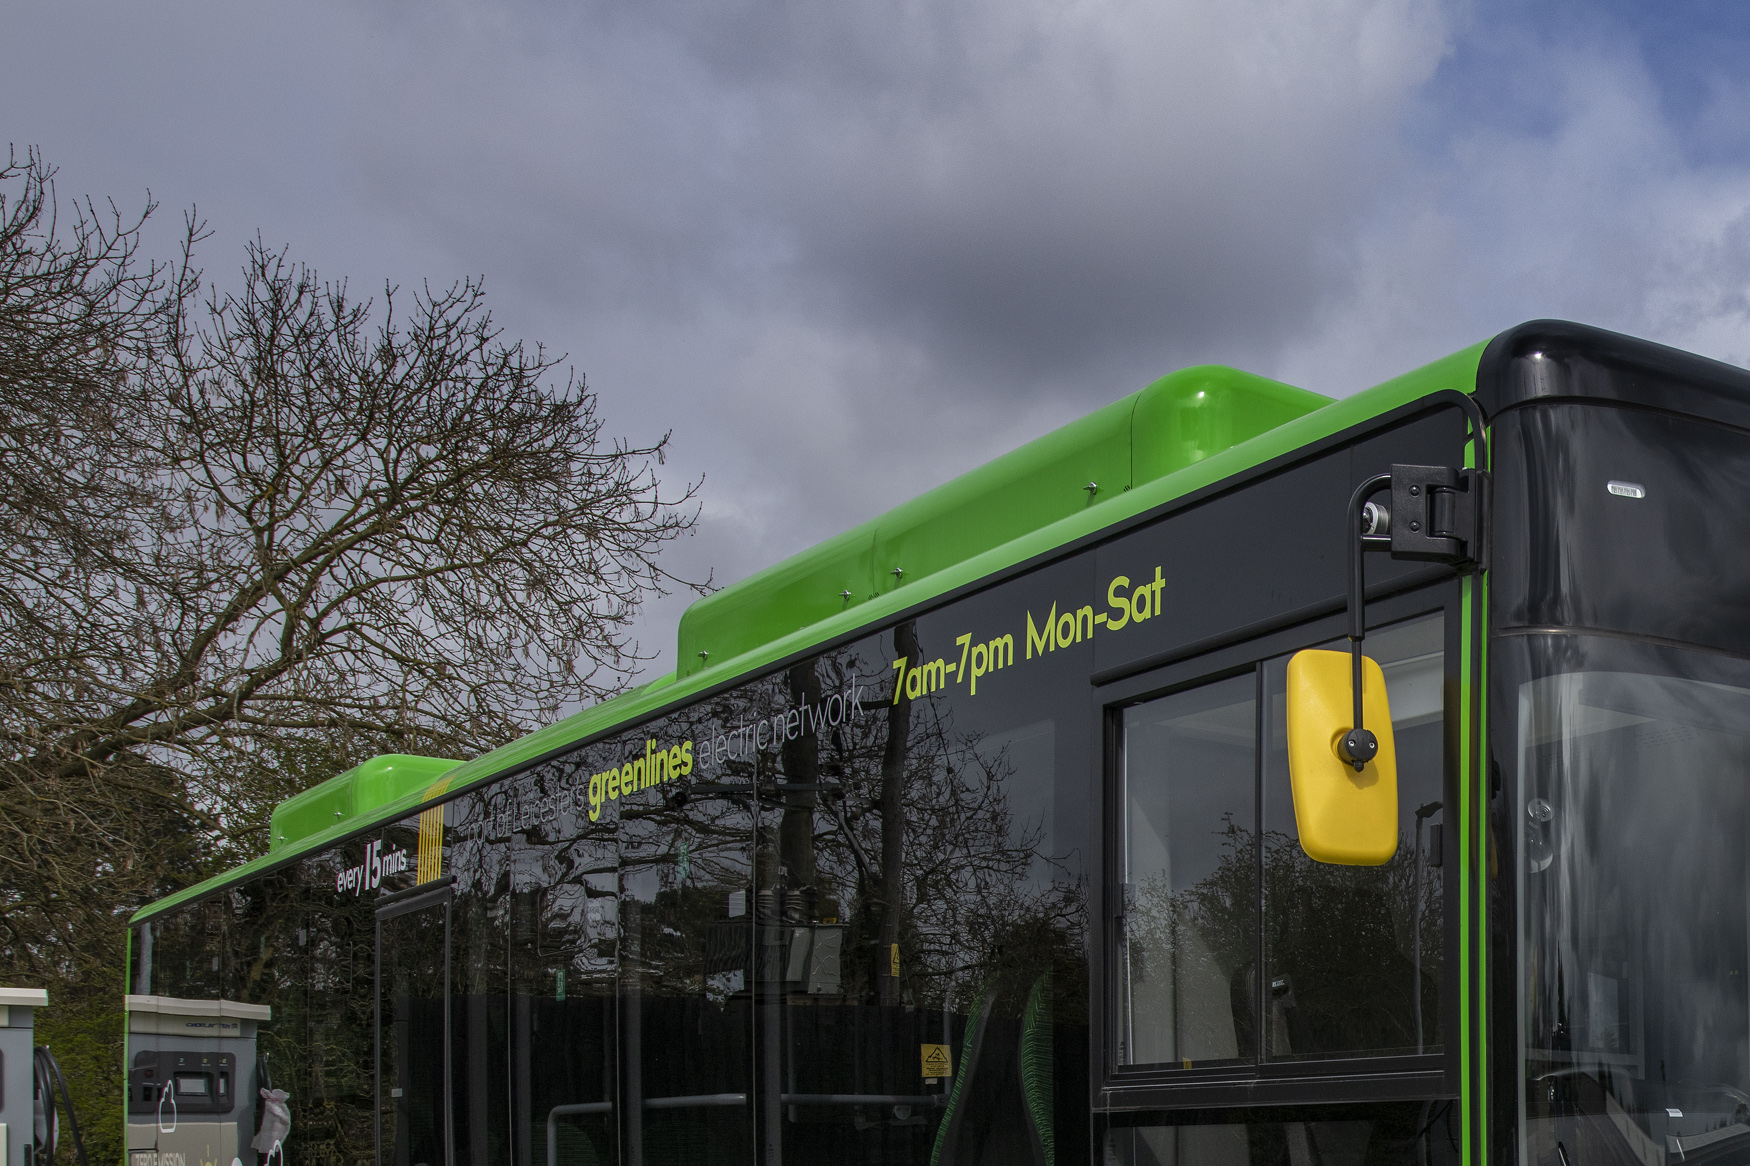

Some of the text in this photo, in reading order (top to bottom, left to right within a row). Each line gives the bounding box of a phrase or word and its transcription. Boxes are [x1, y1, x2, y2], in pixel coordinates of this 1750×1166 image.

[892, 565, 1166, 706] 7am-7pm Mon-Sat
[496, 799, 512, 838] of
[588, 738, 693, 822] greenlines
[699, 712, 768, 770] electric
[773, 673, 864, 746] network
[336, 839, 407, 896] every 15 mins
